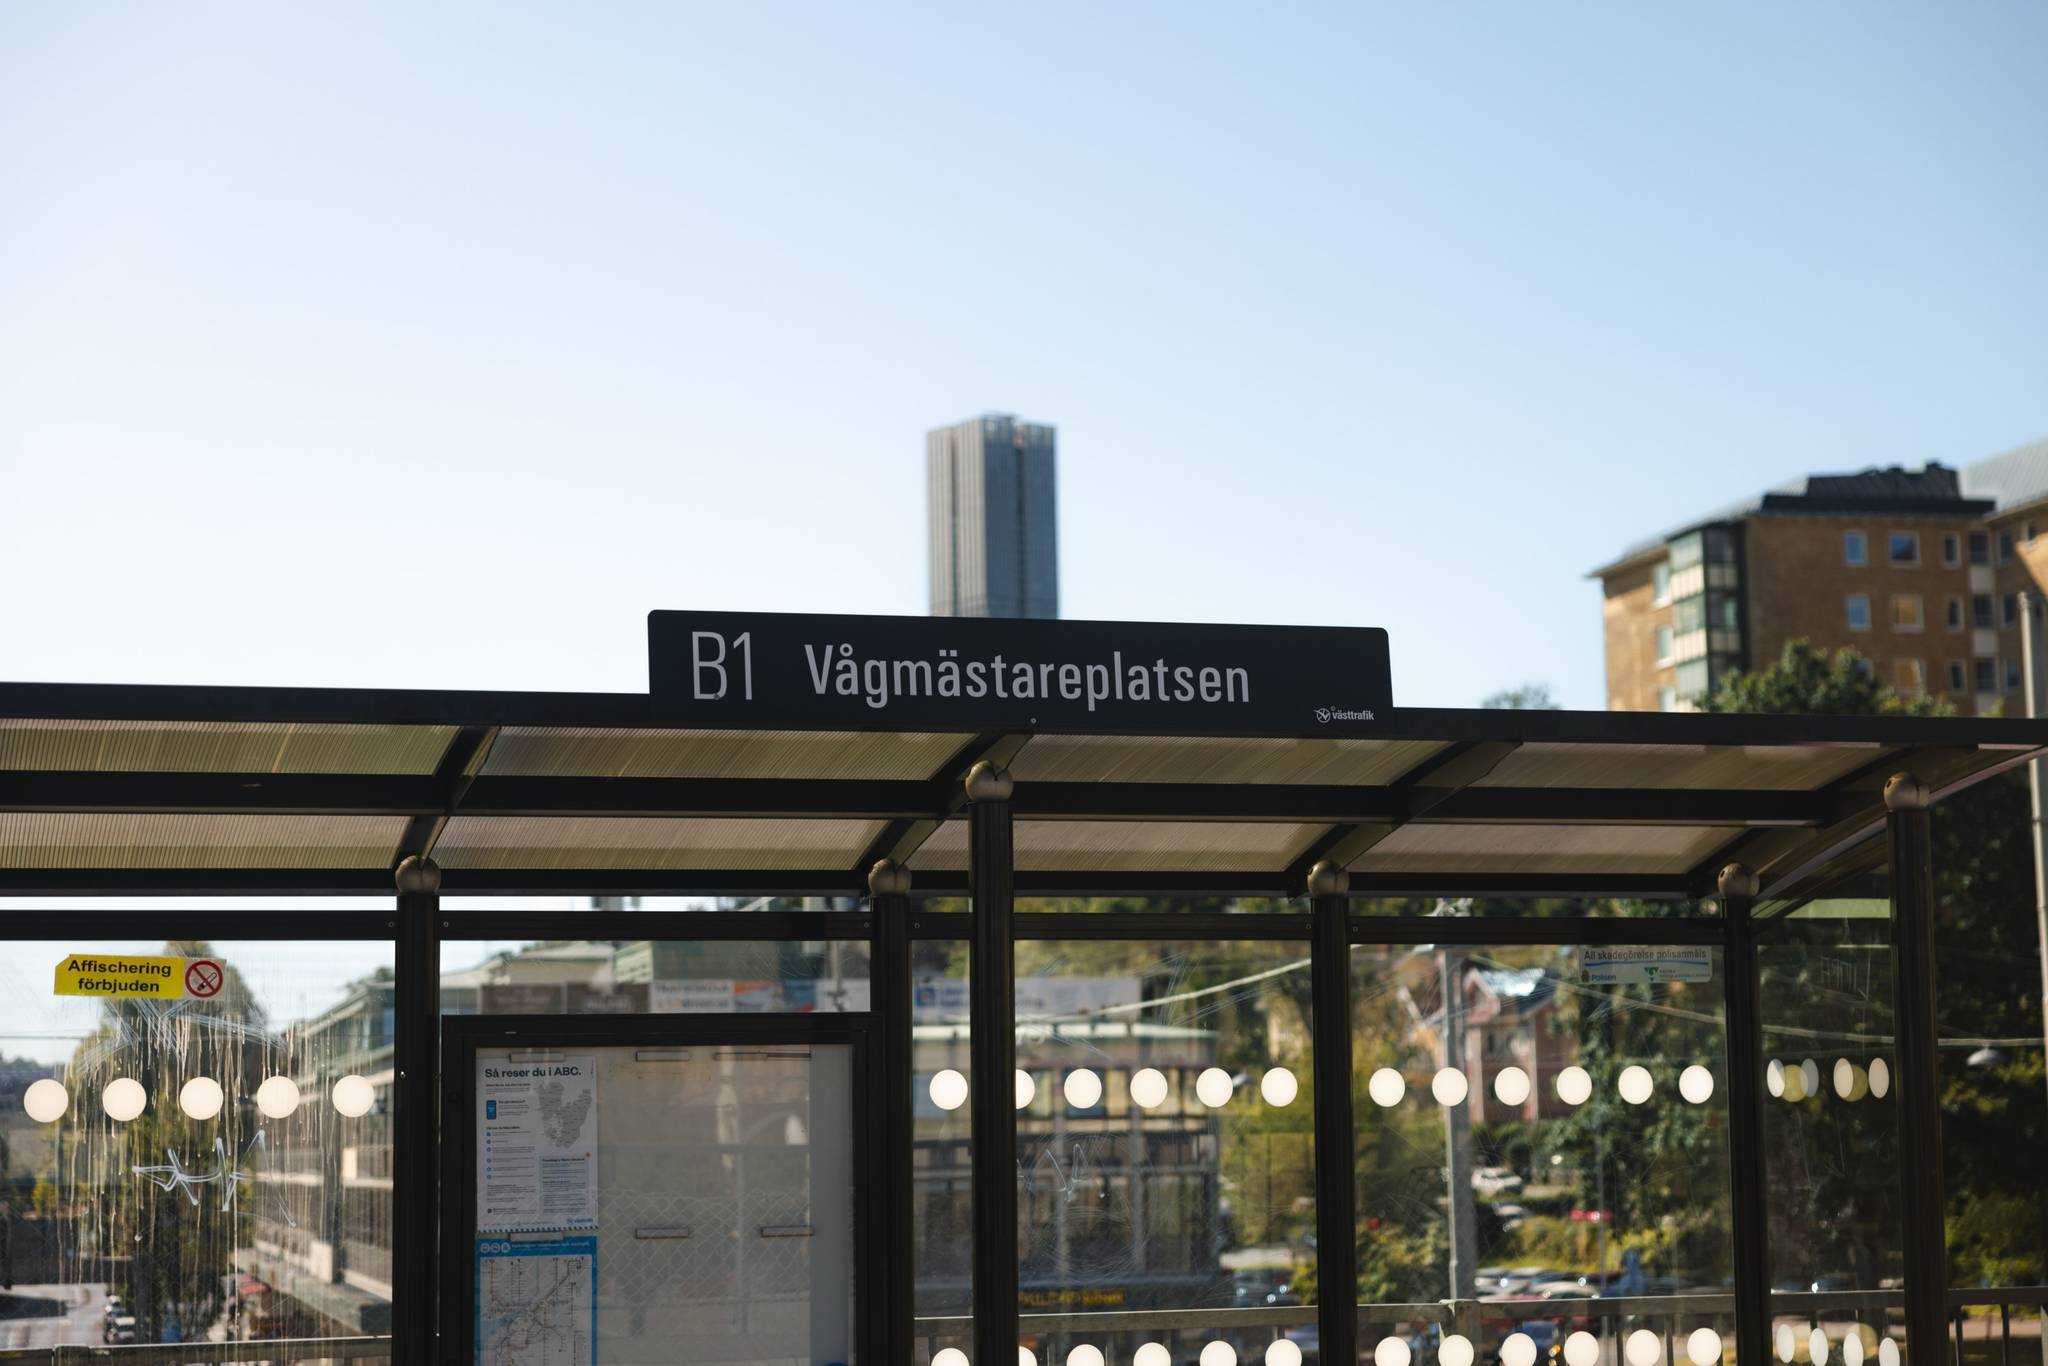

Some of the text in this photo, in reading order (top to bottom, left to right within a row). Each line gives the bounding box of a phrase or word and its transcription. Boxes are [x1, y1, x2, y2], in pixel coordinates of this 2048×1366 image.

[691, 630, 1251, 712] B1 Vågmästareplatsen
[1332, 709, 1374, 720] västtrafik
[1584, 949, 1707, 962] All skadegörelse polisanmäls
[68, 959, 172, 978] Affischering
[1591, 974, 1617, 982] Polisen
[78, 978, 160, 994] förbjuden
[485, 1067, 499, 1078] Så
[502, 1069, 530, 1078] reser
[532, 1067, 546, 1077] du
[554, 1066, 582, 1077] ABC.
